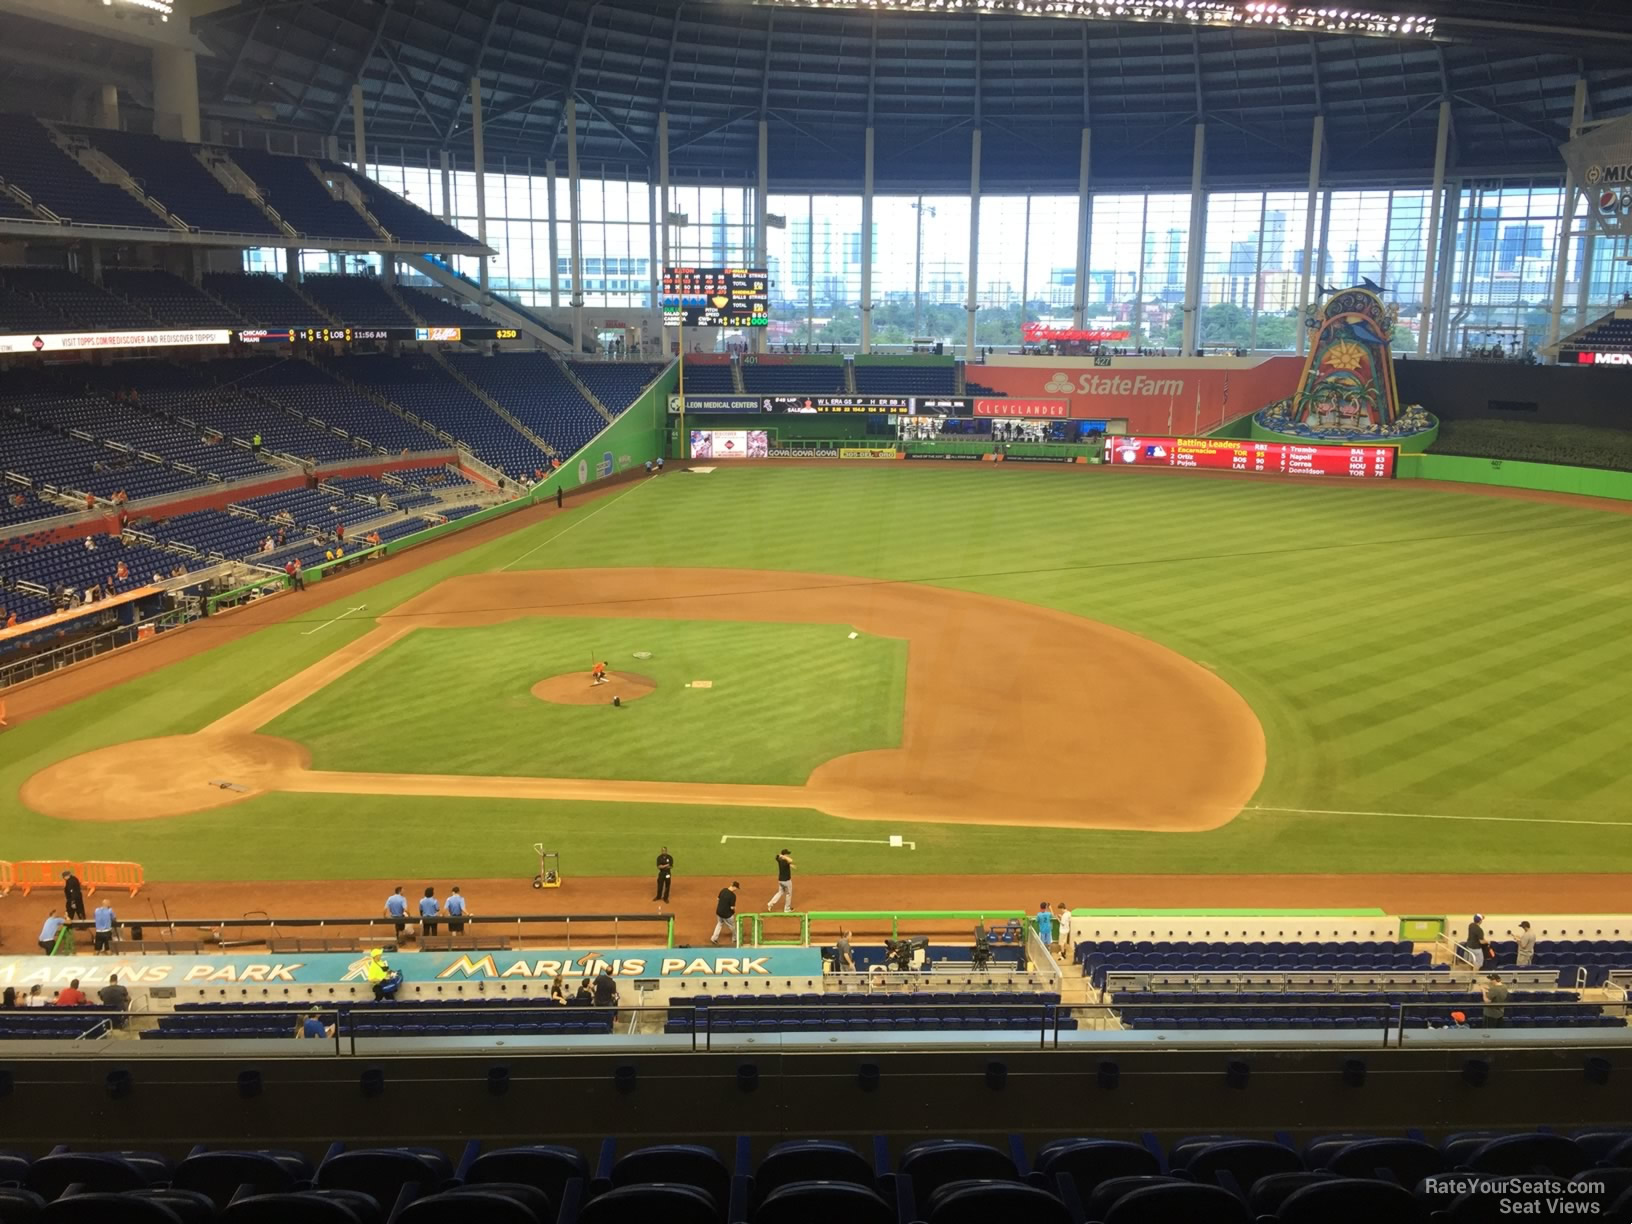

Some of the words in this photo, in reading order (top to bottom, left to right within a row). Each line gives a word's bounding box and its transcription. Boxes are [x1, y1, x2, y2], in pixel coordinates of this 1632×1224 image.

[62, 338, 76, 346] VISIT
[78, 336, 144, 346] TOPPS.COM/REDISCOVER
[147, 335, 158, 343] AND
[160, 334, 193, 343] REDISCOVER
[1095, 357, 1110, 366] 427
[977, 401, 1063, 415] CLEVELANDER
[1177, 439, 1206, 448] Batting
[1209, 440, 1240, 449] Leaders
[434, 952, 648, 978] MARLINS
[660, 957, 772, 975] PARK
[184, 963, 305, 982] PARK
